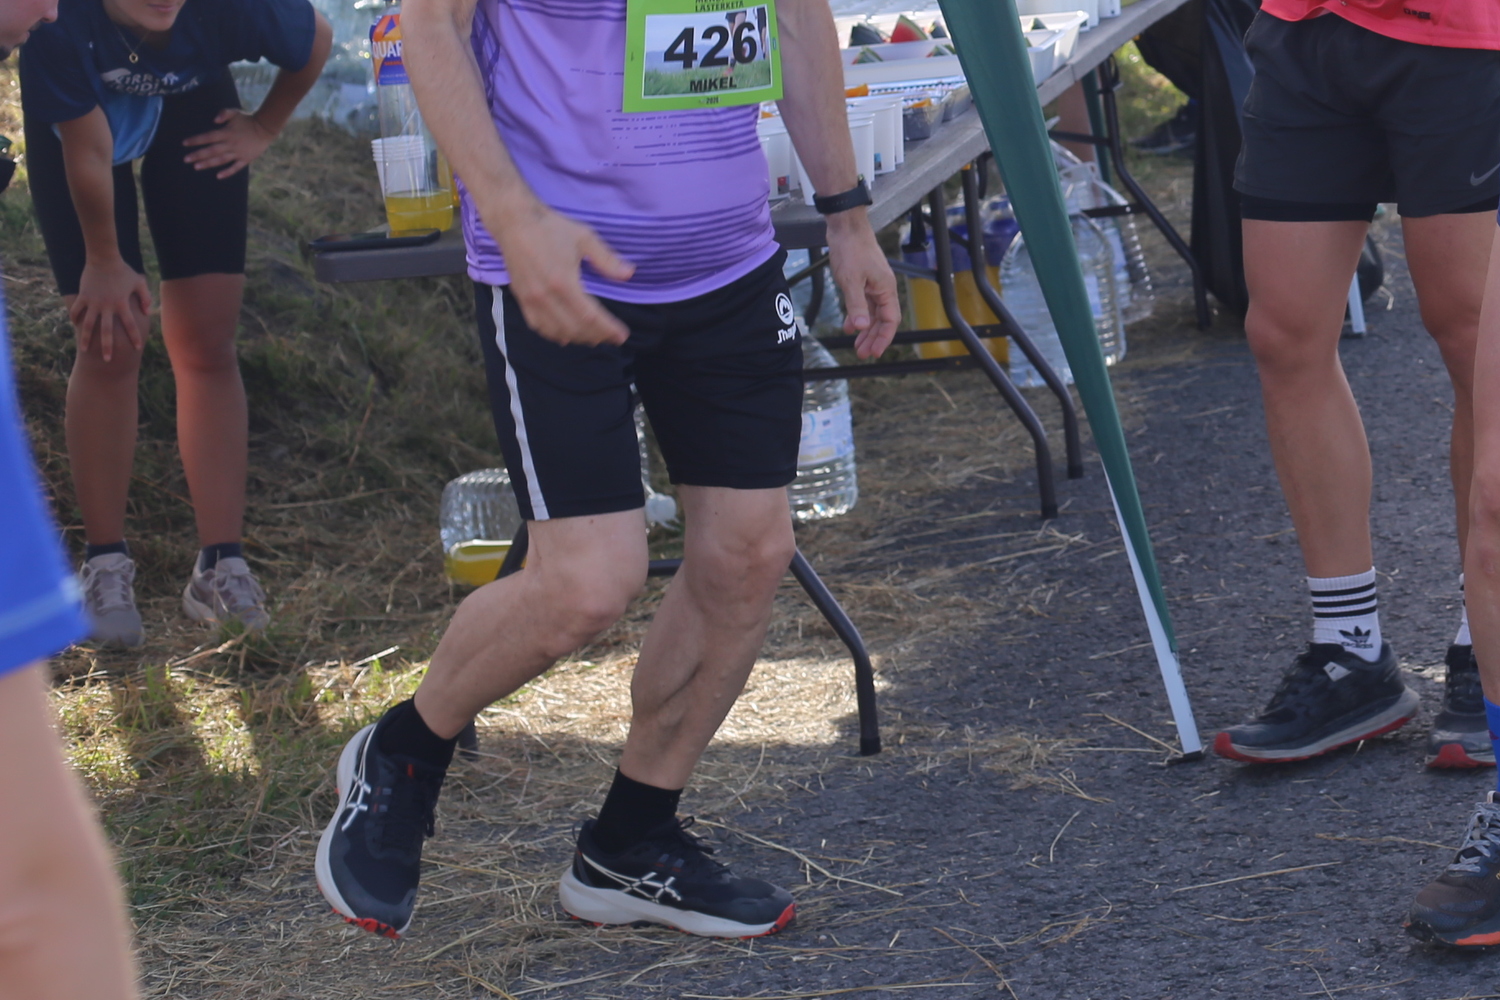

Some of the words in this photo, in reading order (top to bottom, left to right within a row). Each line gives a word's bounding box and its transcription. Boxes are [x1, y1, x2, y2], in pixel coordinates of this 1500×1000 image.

[695, 0, 744, 12] LASTERKETA
[663, 22, 757, 69] 426
[690, 76, 737, 93] MIKEL
